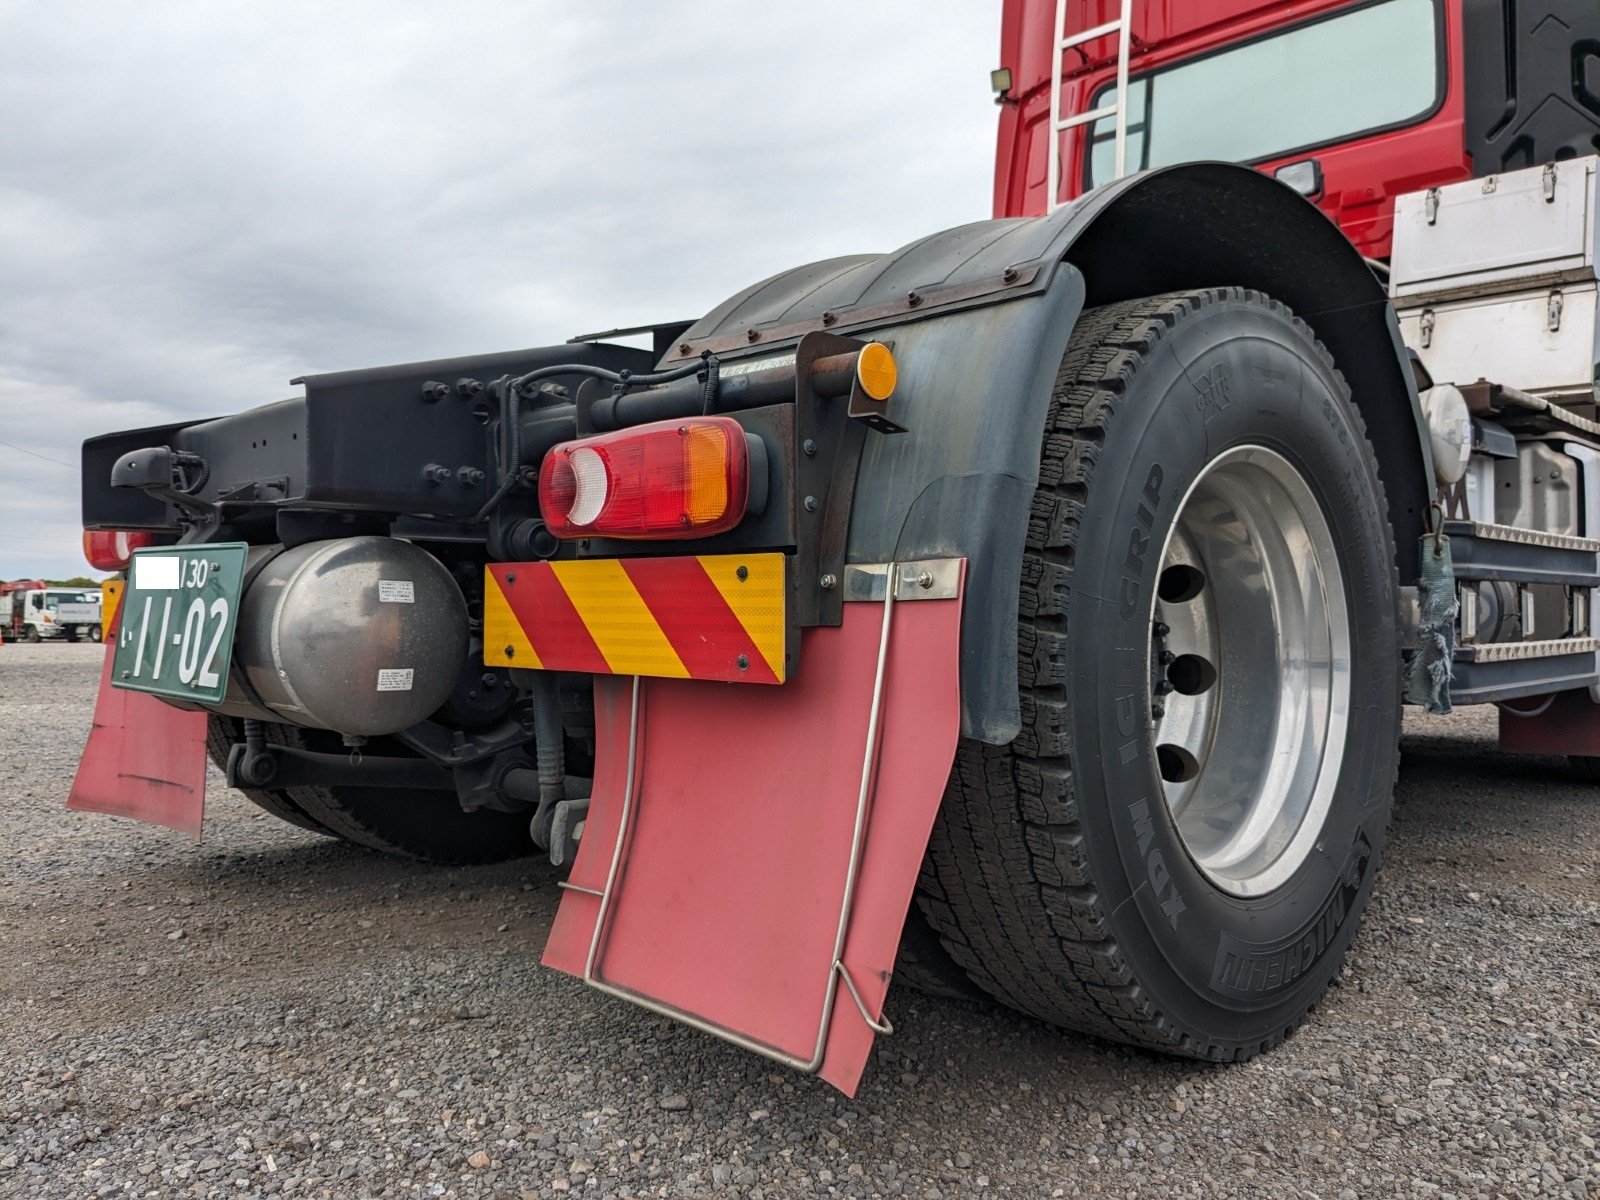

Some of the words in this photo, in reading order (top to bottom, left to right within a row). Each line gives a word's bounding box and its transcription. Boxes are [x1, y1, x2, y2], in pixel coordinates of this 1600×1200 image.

[180, 559, 208, 588] 130
[1119, 462, 1164, 621] GRIP
[133, 597, 229, 688] 11-02
[1114, 647, 1138, 766] ICE
[1127, 797, 1187, 933] XDW
[1216, 888, 1345, 991] MICHELIN
